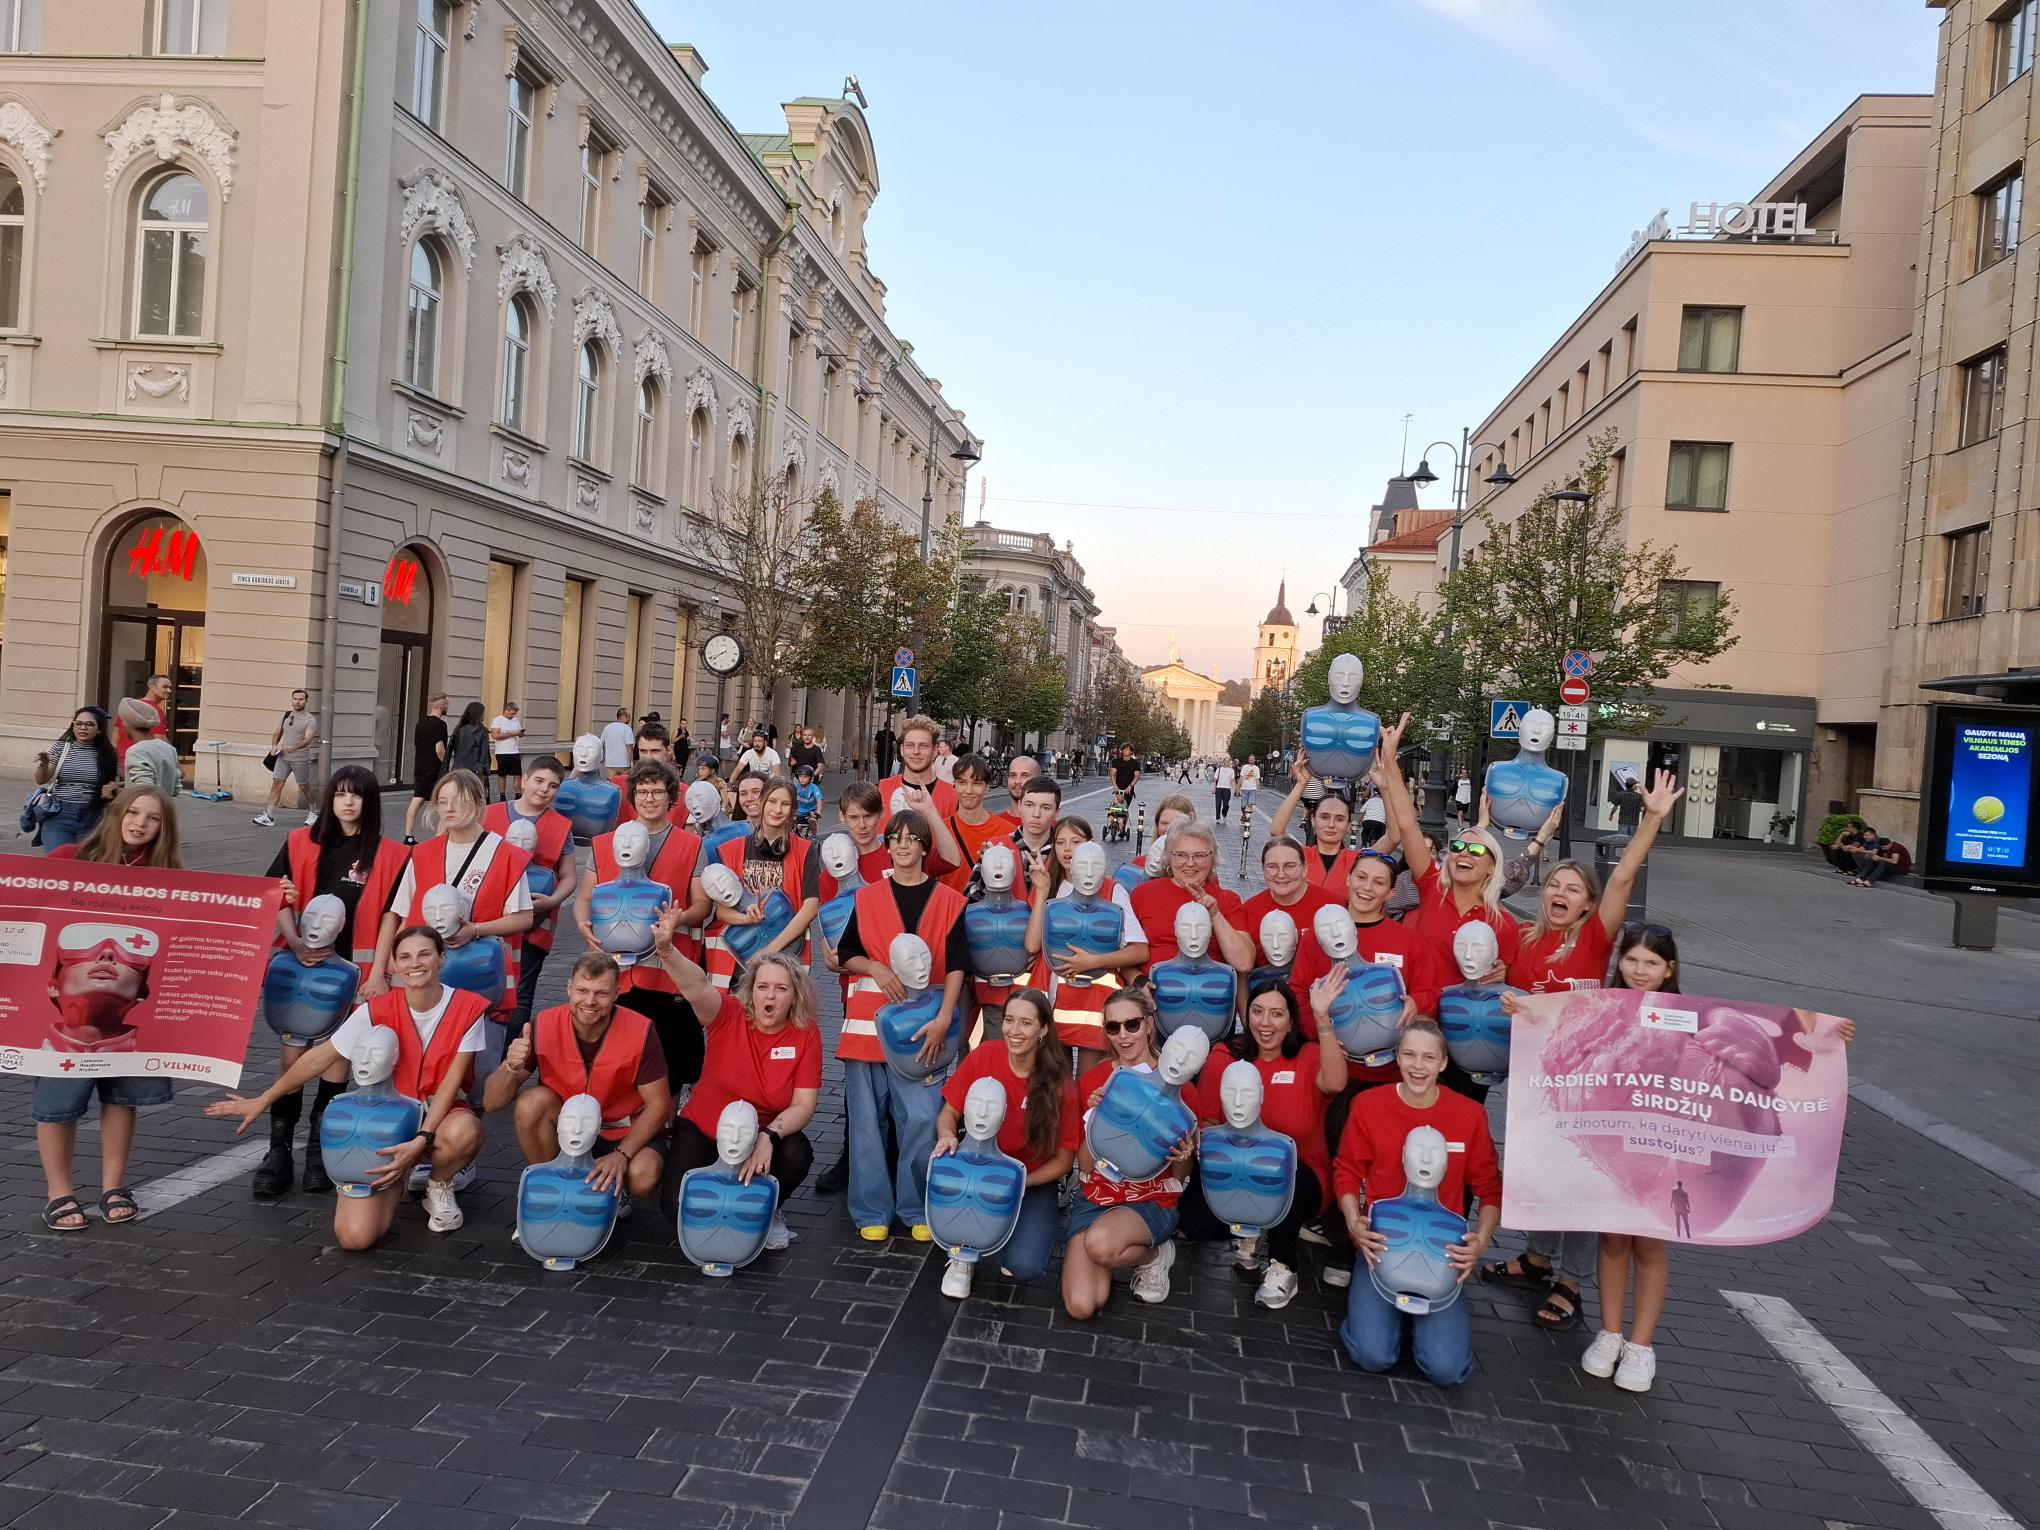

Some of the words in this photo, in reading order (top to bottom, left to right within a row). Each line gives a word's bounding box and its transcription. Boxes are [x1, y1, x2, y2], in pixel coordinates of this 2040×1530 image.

[1689, 201, 1816, 235] HOTEL
[128, 528, 199, 582] H&M
[370, 586, 376, 602] 9
[1963, 737, 1998, 745] VILNIAUS
[1999, 739, 2027, 747] TENISO
[1964, 729, 1998, 737] GAUDYK
[1998, 731, 2026, 741] NAUJĄ
[1968, 745, 2020, 754] AKADEMIJOS
[1977, 752, 2010, 763] SEZONĄ
[0, 876, 69, 891] MOSIOS
[73, 881, 168, 899] PAGALBOS
[171, 890, 262, 909] FESTIVALIS
[163, 1061, 212, 1074] VILNIUS
[1528, 1072, 1607, 1089] KASDIEN
[1613, 1072, 1665, 1090] TAVE
[1669, 1077, 1725, 1100] SUPA
[1729, 1087, 1830, 1114] DAUGYBĖ
[1631, 1090, 1713, 1123] ŠIRDŽIŲ
[1555, 1120, 1568, 1129] ar
[1572, 1116, 1636, 1131] žinotum,
[1640, 1119, 1658, 1134] ką
[1661, 1122, 1708, 1143] daryti
[1710, 1133, 1757, 1152] vienai
[1758, 1140, 1776, 1155] jų
[1629, 1134, 1705, 1157] sustojus?
